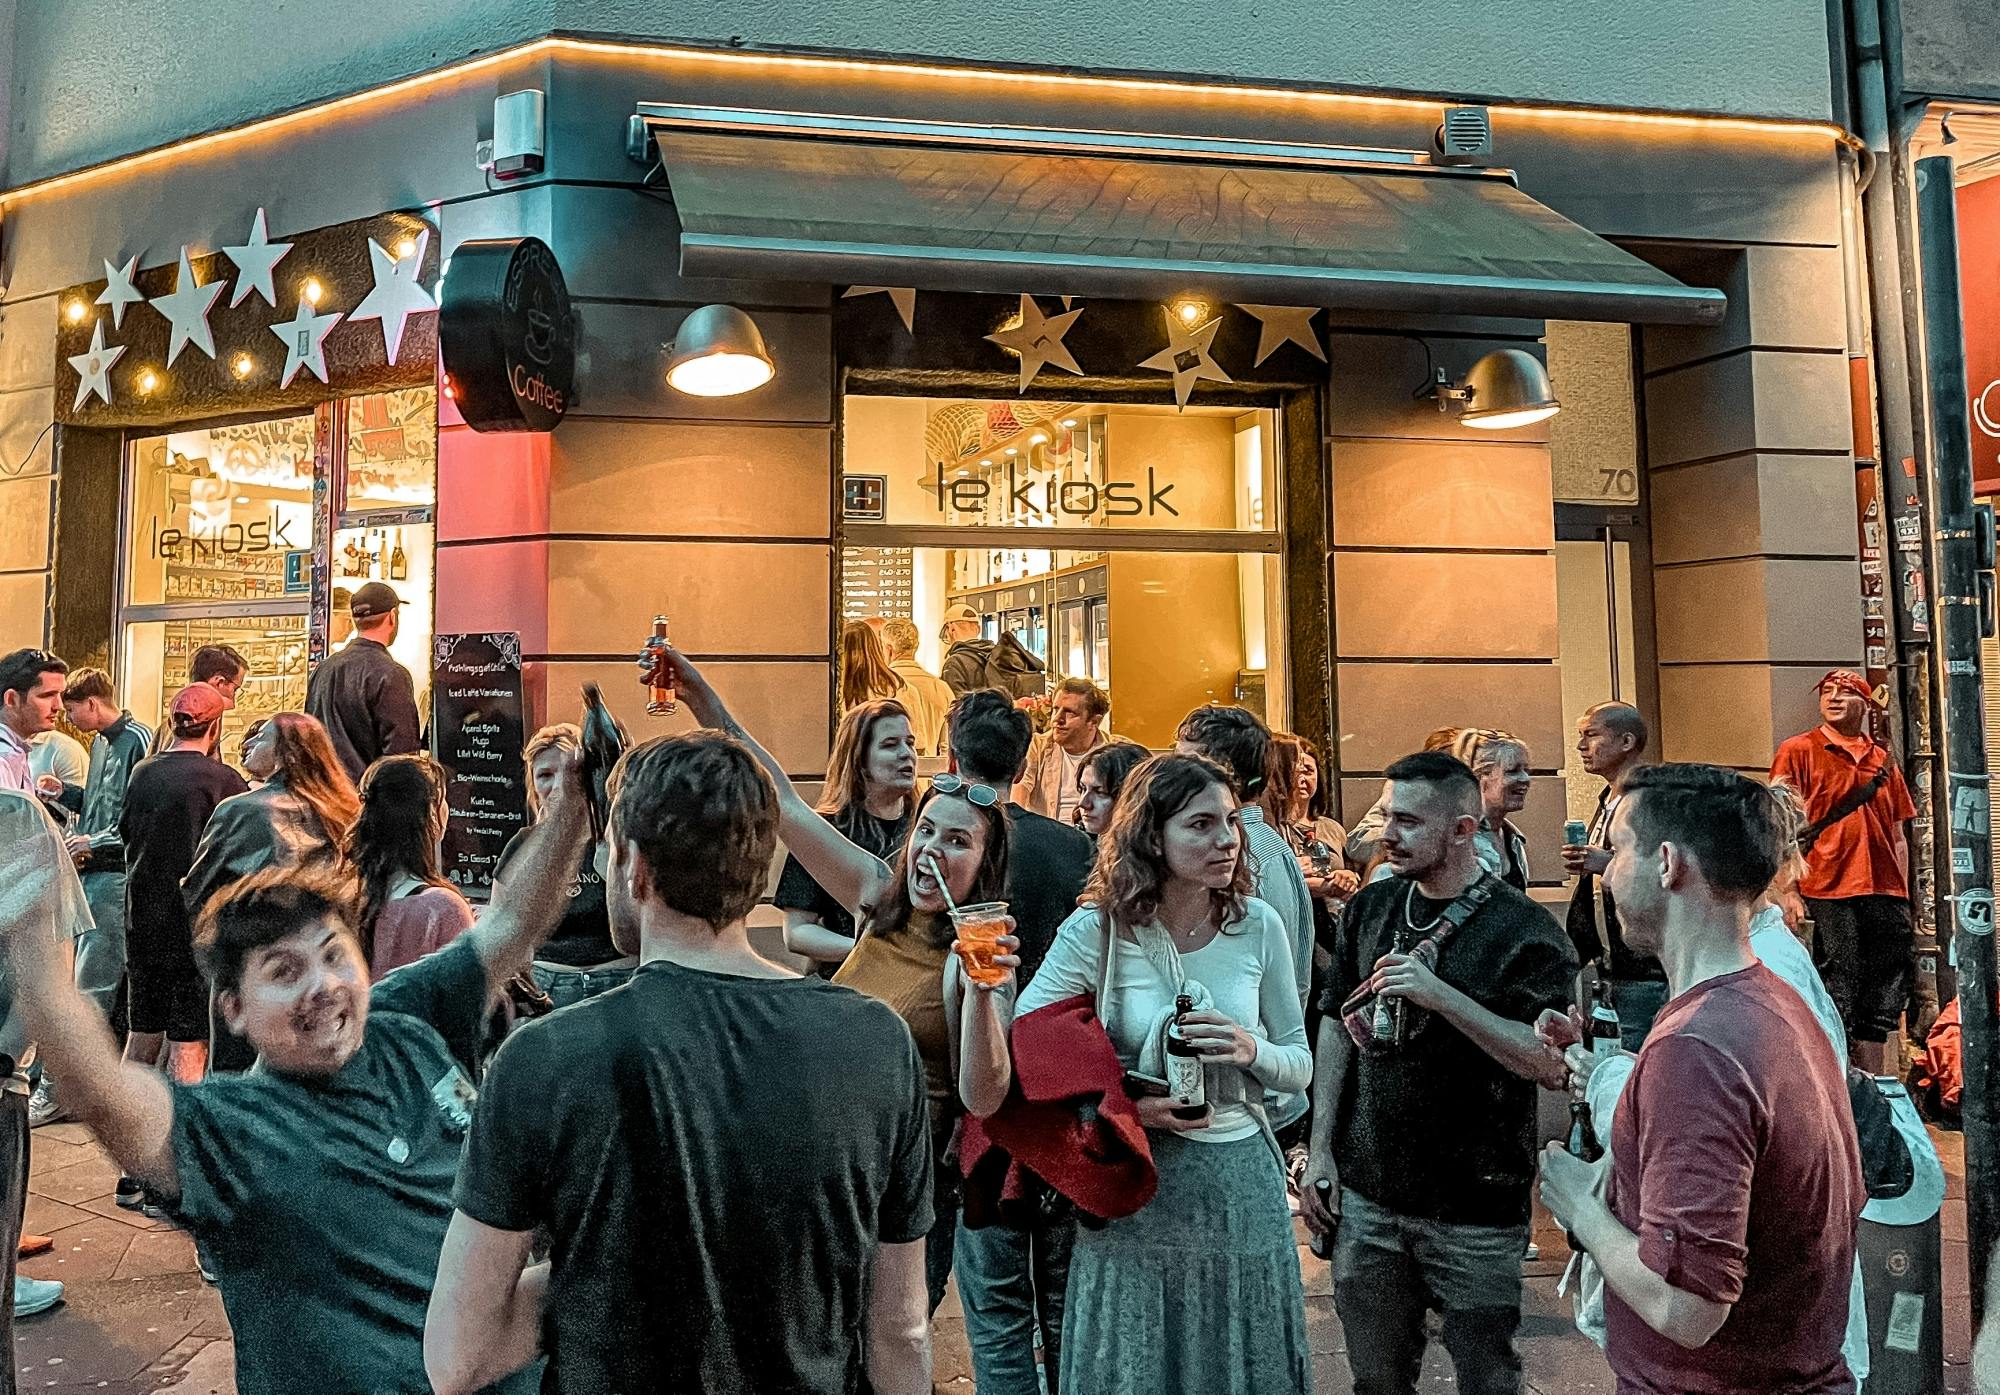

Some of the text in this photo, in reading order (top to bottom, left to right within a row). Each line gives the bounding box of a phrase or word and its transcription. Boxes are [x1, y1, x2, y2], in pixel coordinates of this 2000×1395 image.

[514, 363, 563, 414] Coffee
[1599, 468, 1637, 497] 70
[938, 461, 1179, 517] le kiosk
[151, 505, 295, 563] le kiosk
[480, 688, 513, 697] Variationen
[461, 723, 481, 734] Aperol
[472, 736, 489, 748] Hugo
[486, 751, 503, 762] Berry
[457, 773, 507, 783] Bio-Weinschorle
[470, 796, 495, 806] Kuchen
[457, 852, 469, 862] So
[470, 854, 491, 864] Good
